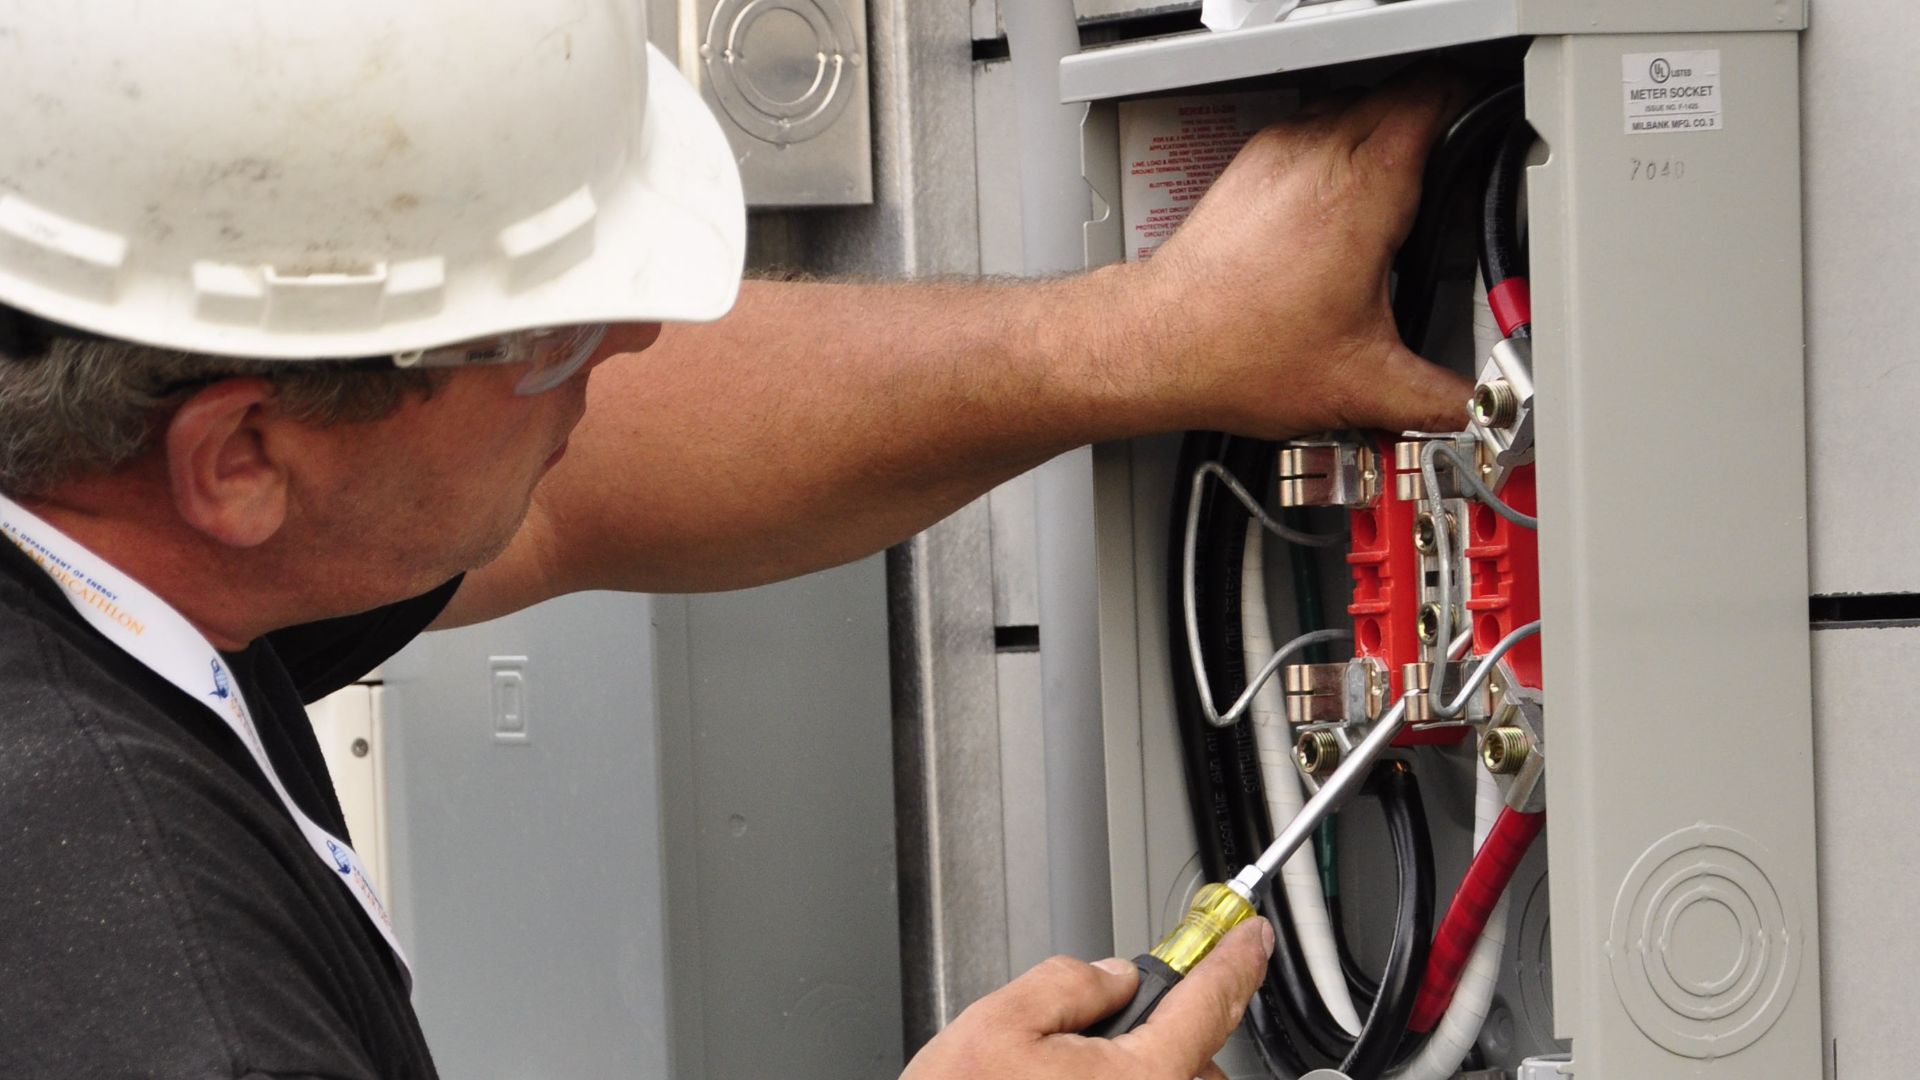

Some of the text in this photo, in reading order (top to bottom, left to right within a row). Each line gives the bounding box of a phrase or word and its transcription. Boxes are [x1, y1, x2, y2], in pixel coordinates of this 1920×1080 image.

[1670, 69, 1692, 77] LISTED
[1630, 85, 1714, 100] METER SOCKET
[1632, 120, 1670, 130] MILBANK
[20, 533, 72, 571] DEPARTMENT
[73, 569, 84, 578] OF
[86, 578, 118, 601] ENERGY
[49, 565, 145, 635] DECATHLON
